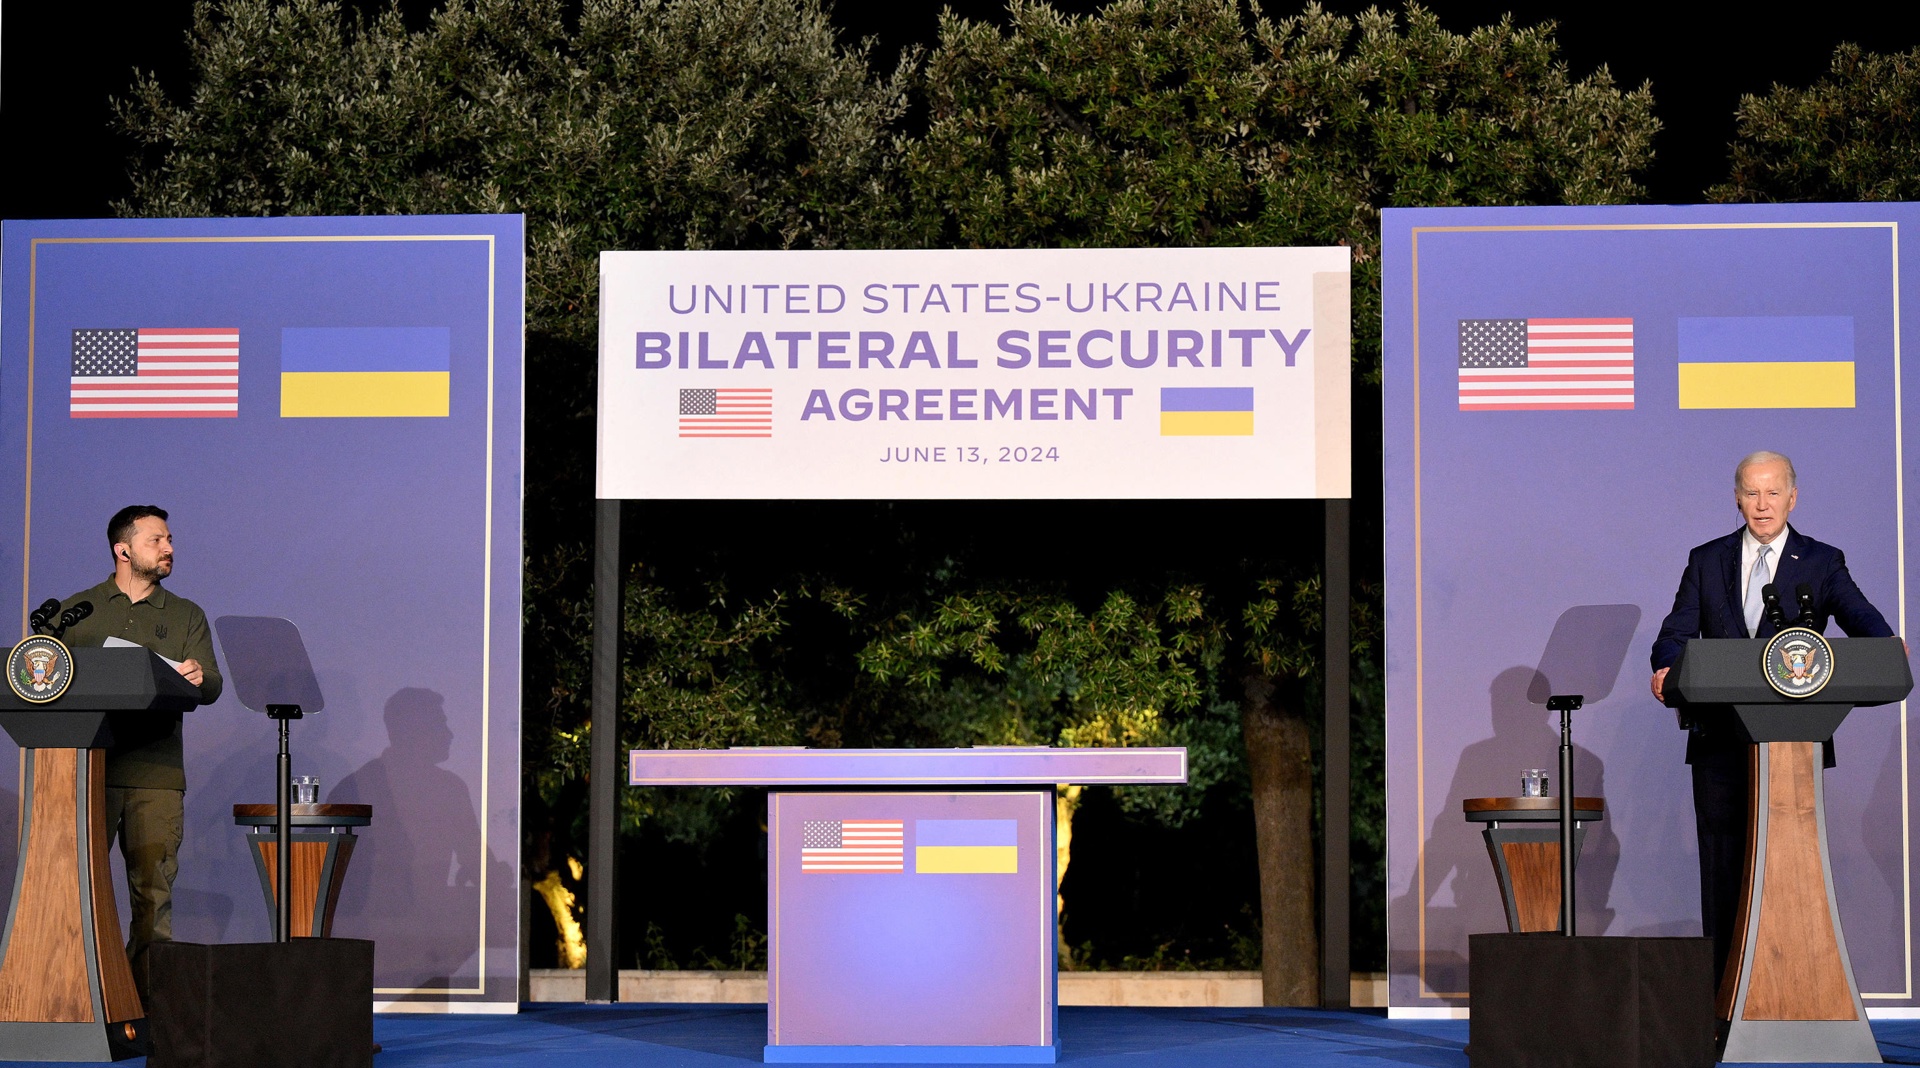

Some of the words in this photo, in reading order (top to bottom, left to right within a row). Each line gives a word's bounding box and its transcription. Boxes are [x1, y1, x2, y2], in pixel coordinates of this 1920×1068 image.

[669, 284, 846, 315] UNITED
[862, 281, 1281, 314] STATES-UKRAINE
[635, 330, 979, 370] BILATERAL
[996, 328, 1312, 370] SECURITY
[800, 388, 1134, 422] AGREEMENT
[879, 447, 946, 463] JUNE
[956, 447, 988, 465] 13,
[998, 446, 1060, 463] 2024
